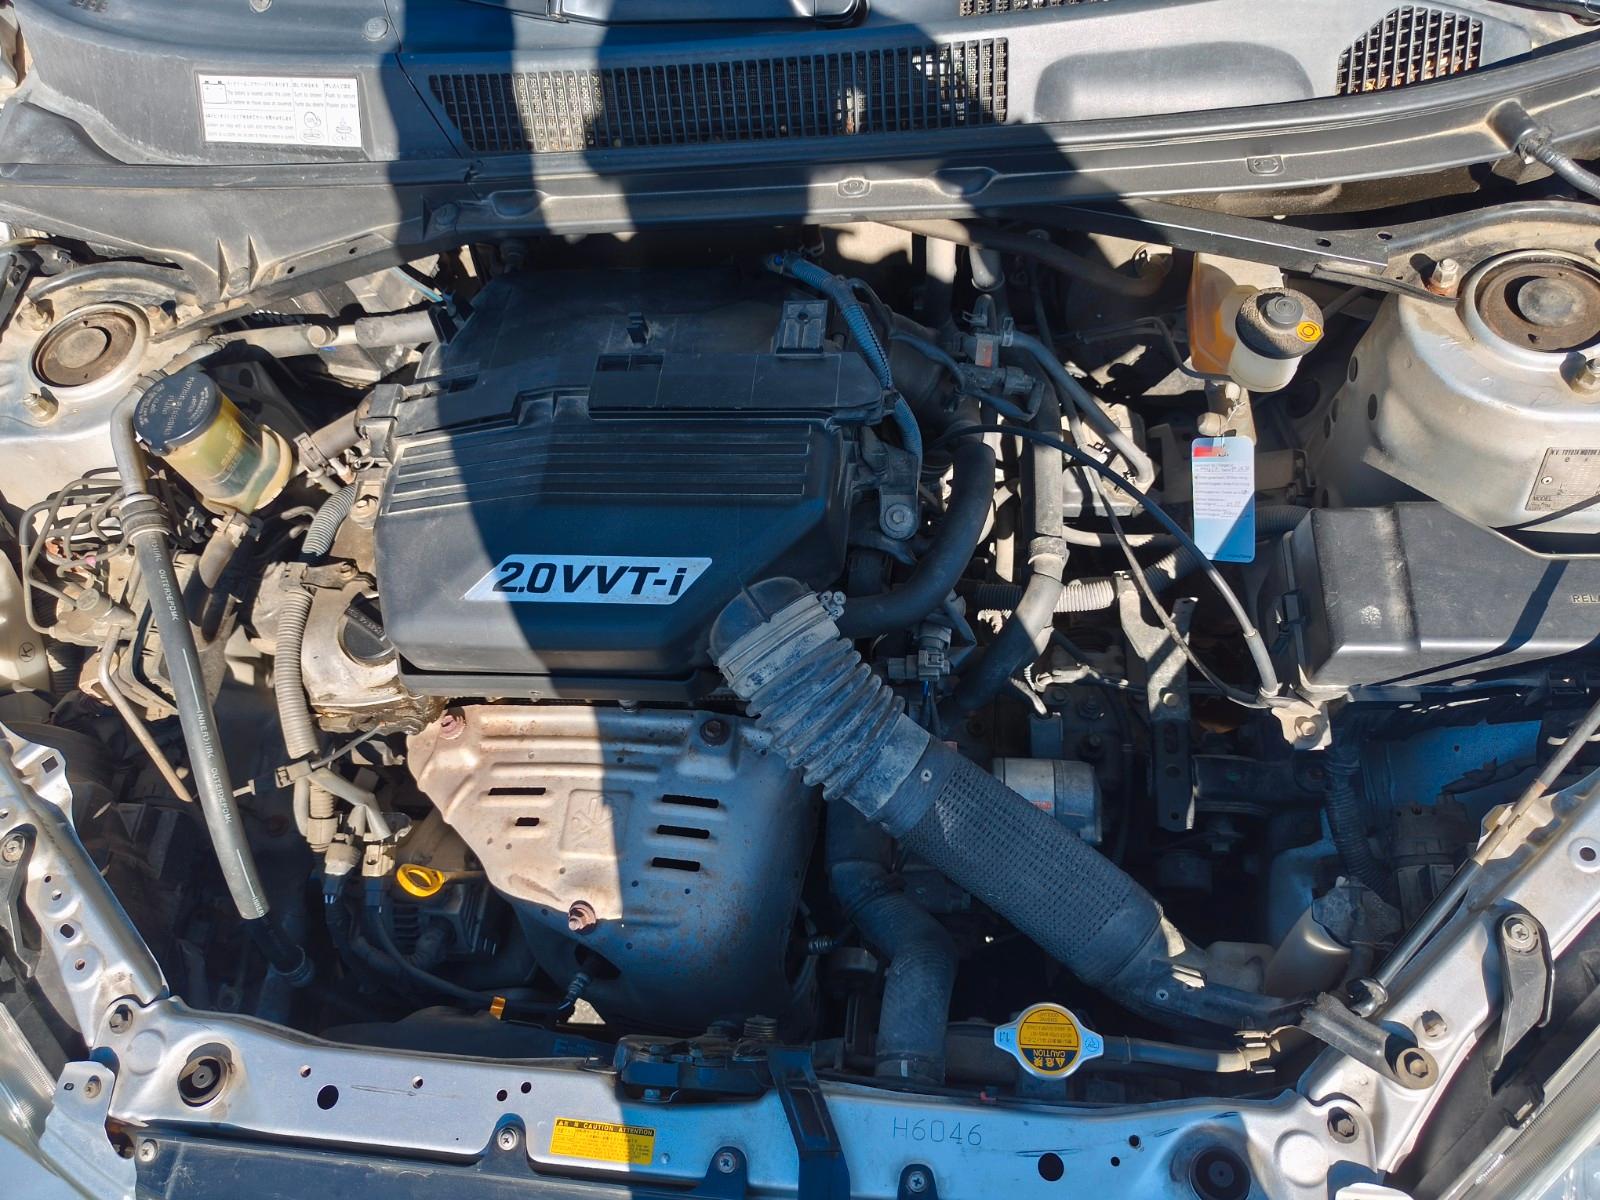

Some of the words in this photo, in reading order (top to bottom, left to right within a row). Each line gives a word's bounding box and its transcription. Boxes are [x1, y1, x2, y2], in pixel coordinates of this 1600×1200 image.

[1572, 594, 1600, 603] REL
[1033, 1049, 1066, 1057] CAUTION
[583, 1122, 614, 1131] CAUTION
[618, 1127, 653, 1136] ATTENTION
[892, 1116, 982, 1146] H6046
